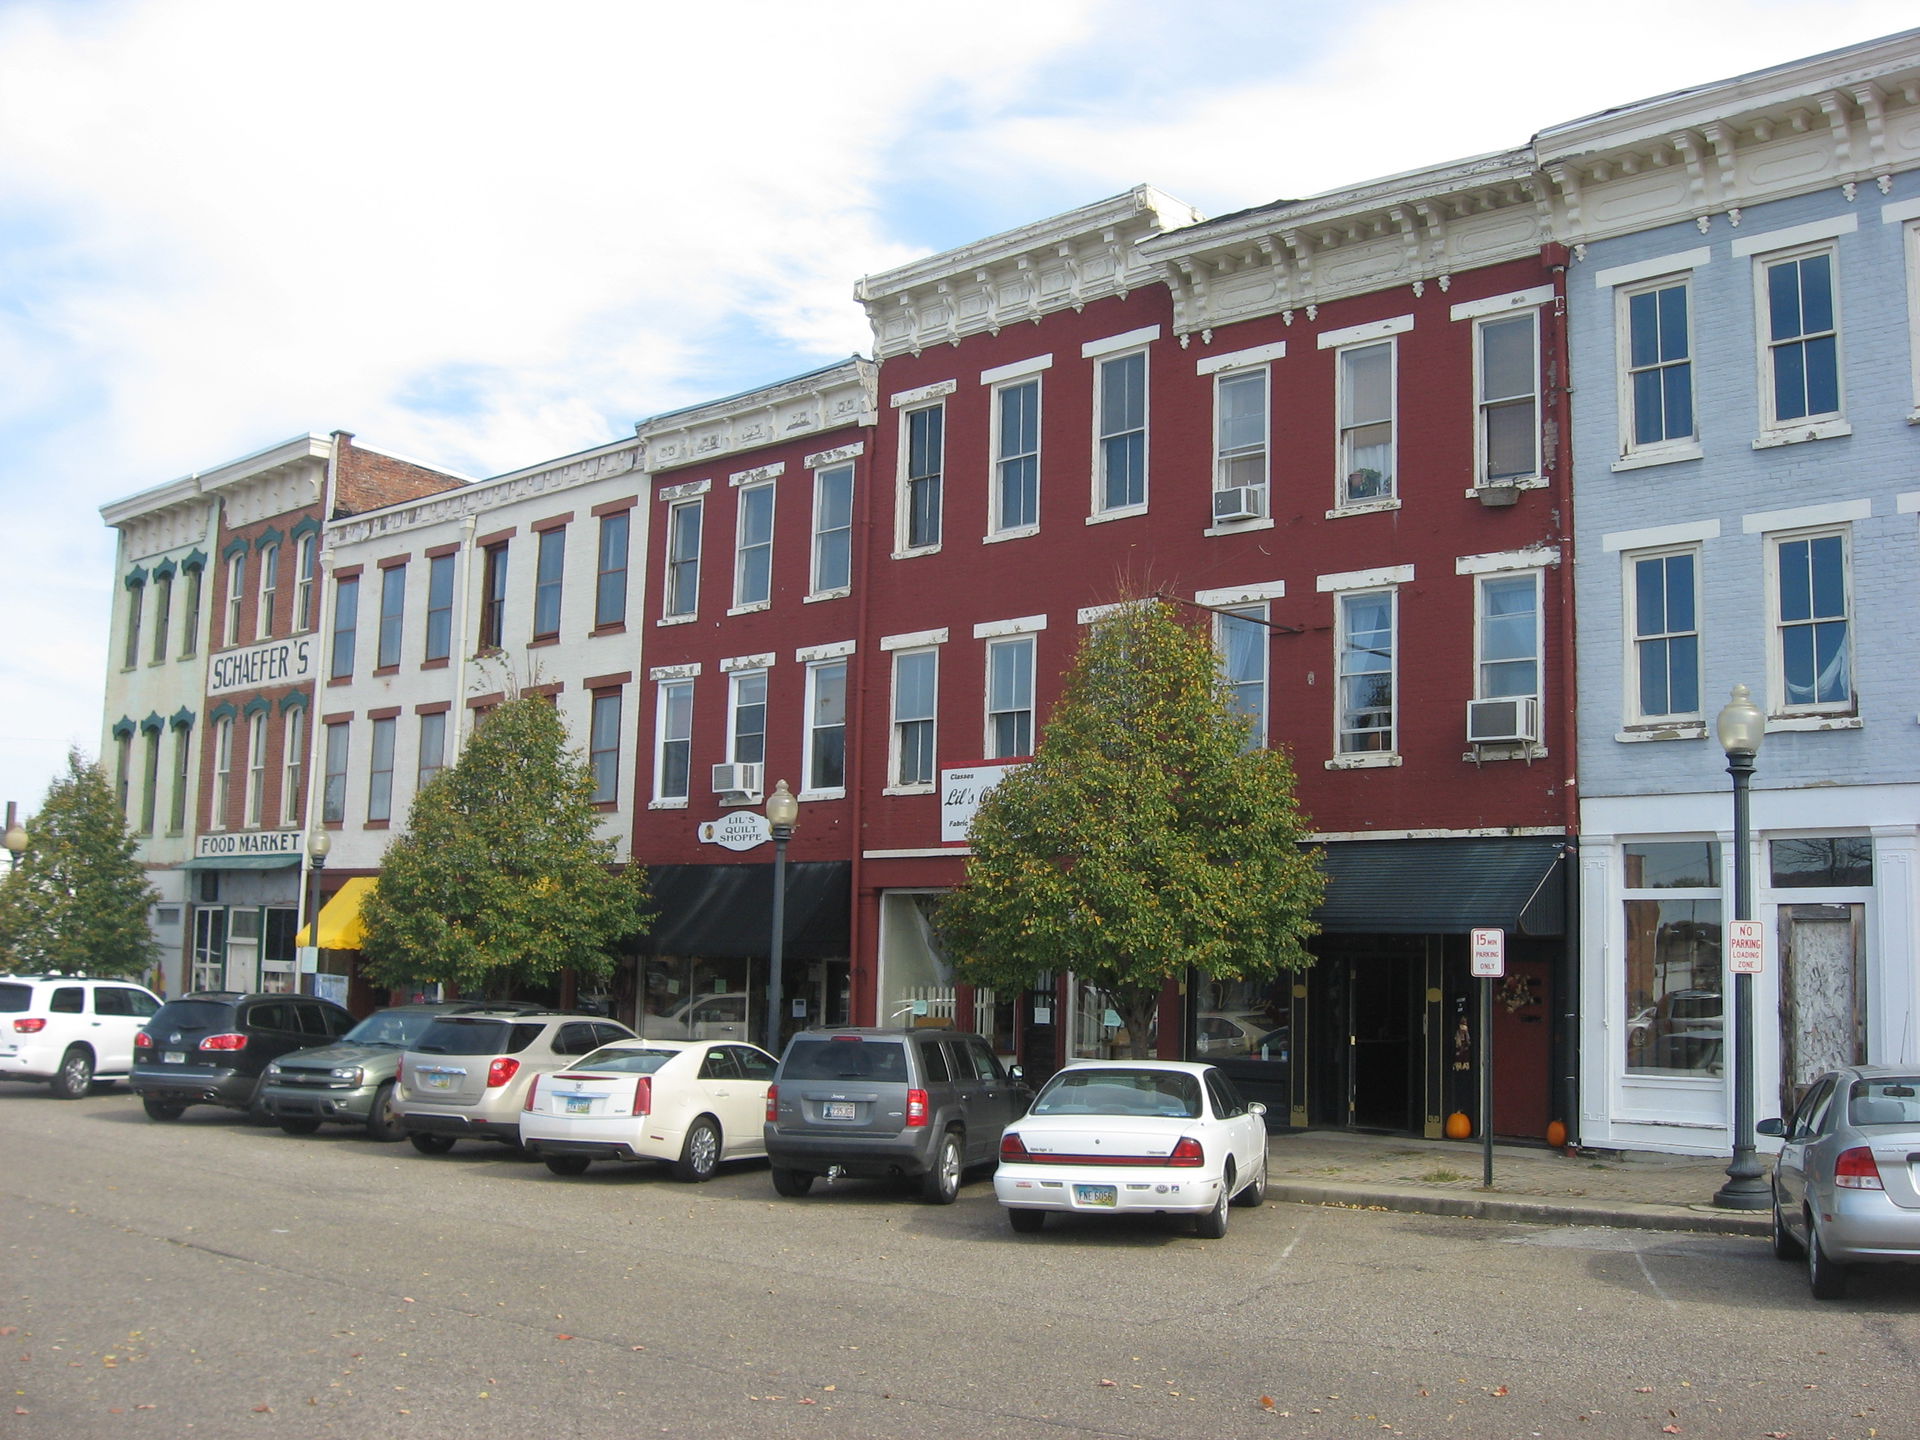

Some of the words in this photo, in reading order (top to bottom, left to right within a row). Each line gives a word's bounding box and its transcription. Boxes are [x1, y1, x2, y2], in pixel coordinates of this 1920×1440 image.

[213, 641, 309, 689] SCHAEFER'S
[944, 788, 975, 806] Lil's
[728, 816, 755, 824] LIL'S
[725, 826, 758, 834] QUILT
[720, 834, 762, 842] SHOPPE
[202, 837, 235, 853] FOOD
[239, 834, 300, 851] MARKET
[1740, 927, 1752, 936] NO
[1476, 934, 1486, 945] 15
[1732, 939, 1761, 949] PARKING
